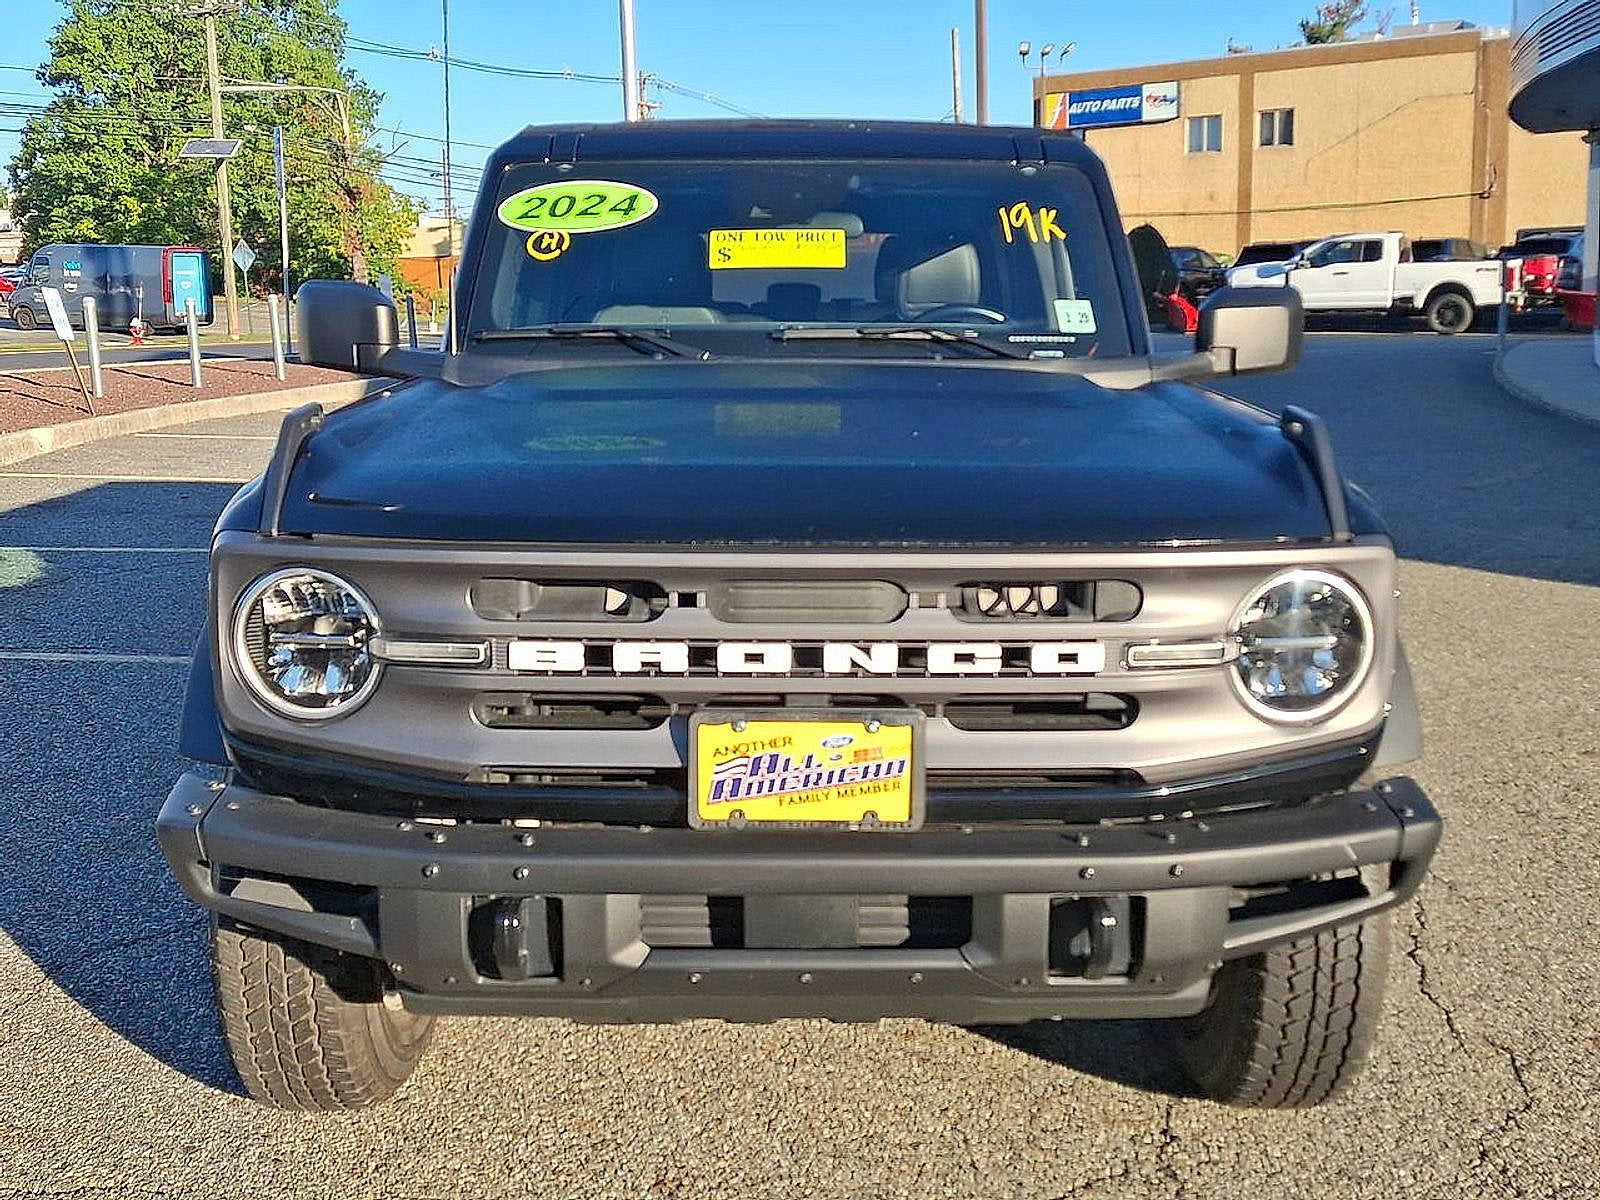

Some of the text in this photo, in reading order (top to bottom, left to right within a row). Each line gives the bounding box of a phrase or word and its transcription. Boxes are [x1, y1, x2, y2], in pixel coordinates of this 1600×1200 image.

[1069, 97, 1141, 115] AUTO PARTS
[516, 194, 639, 220] 2024
[716, 231, 841, 242] ONE LOW PRICE
[717, 247, 732, 263] $
[507, 641, 1105, 674] BRONCO
[713, 736, 793, 757] ANOTHER
[779, 780, 901, 806] FAMILY MEMBER
